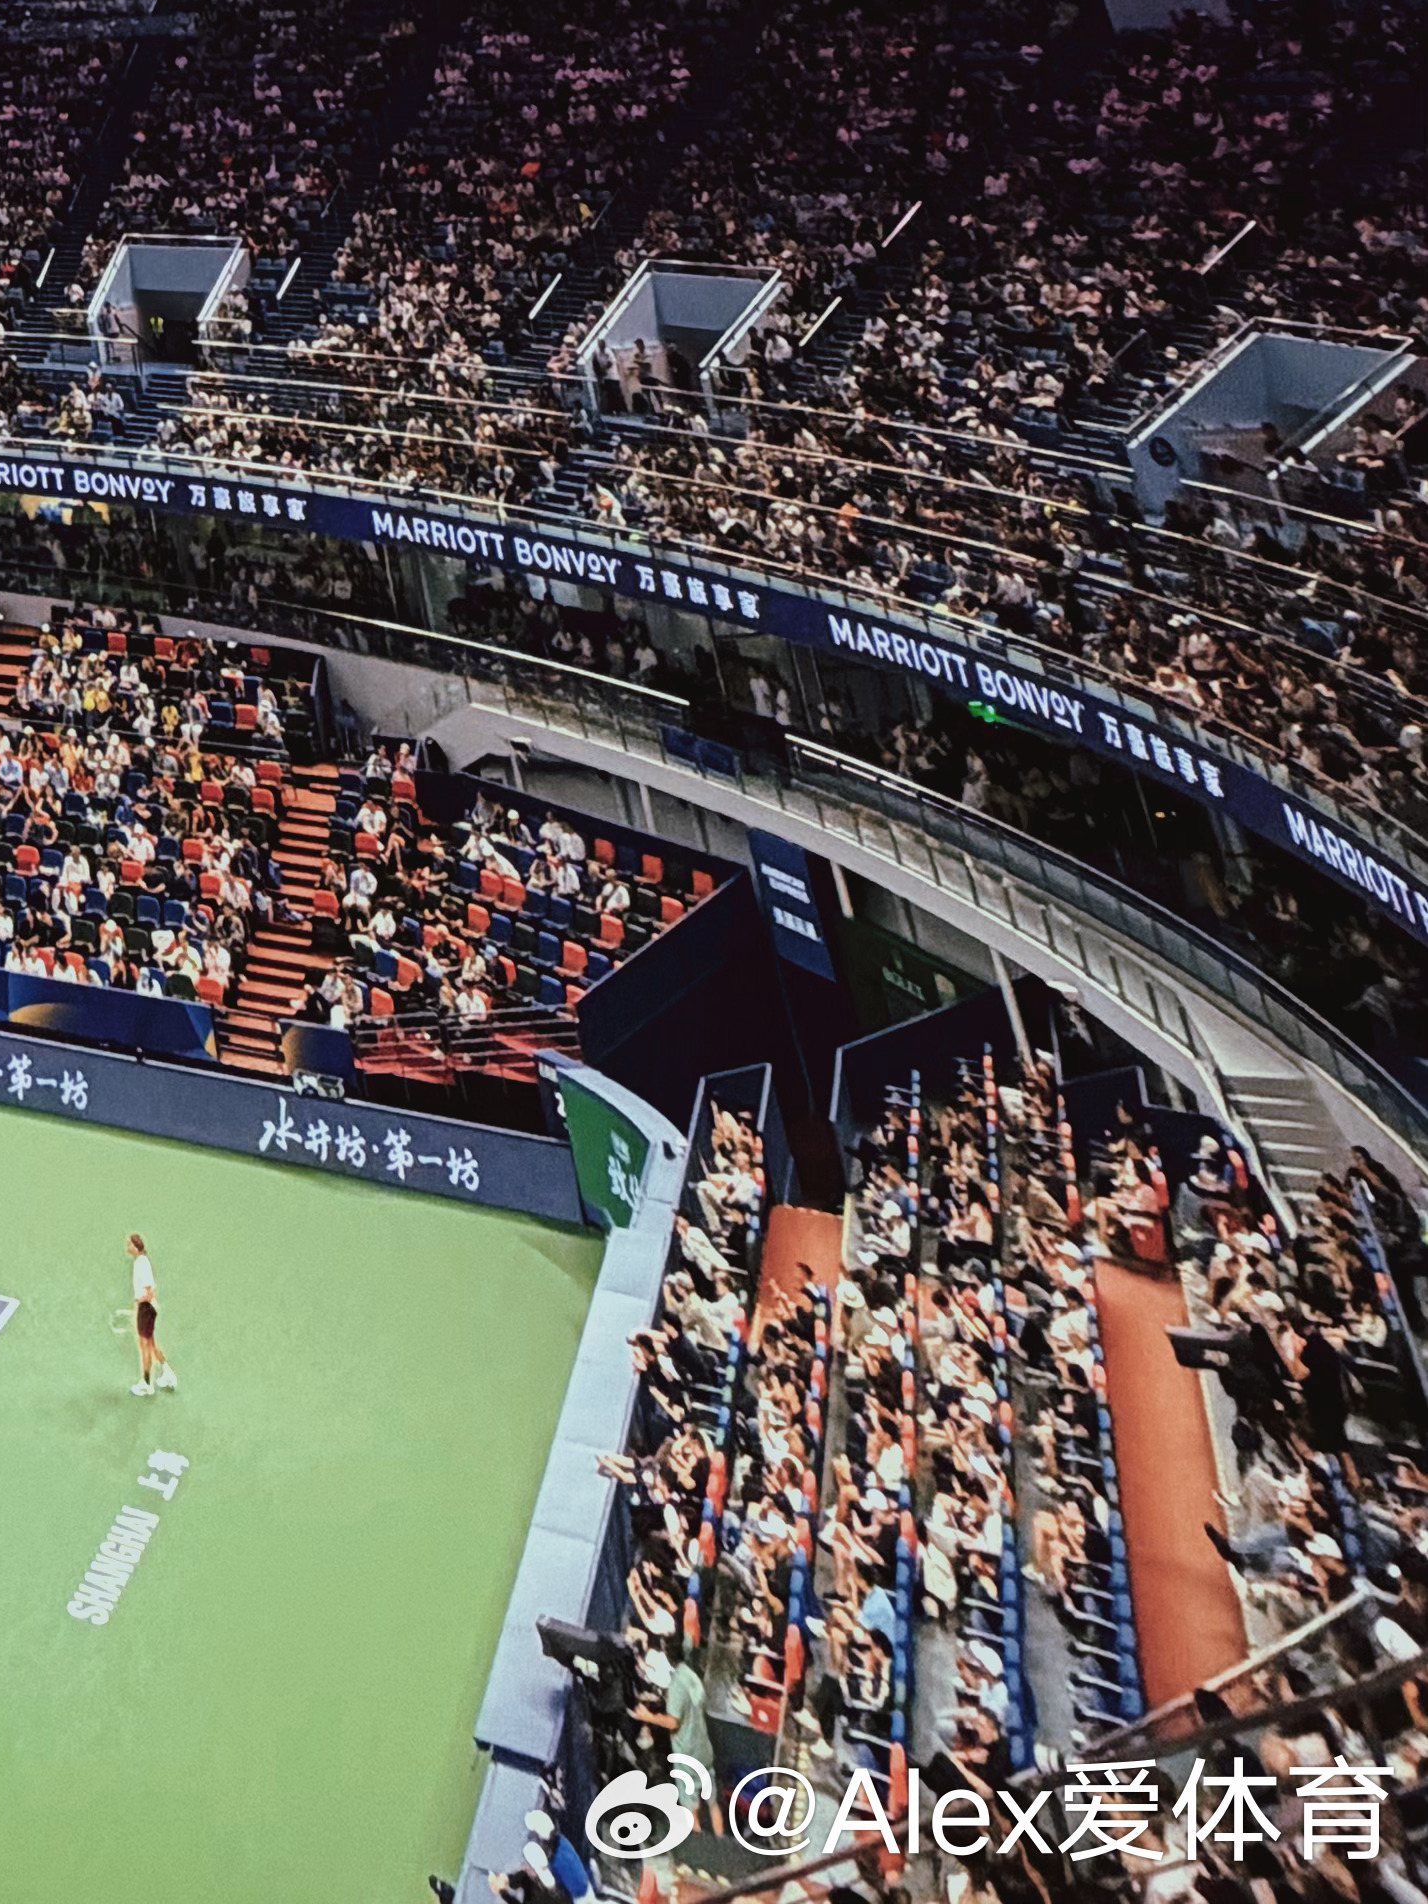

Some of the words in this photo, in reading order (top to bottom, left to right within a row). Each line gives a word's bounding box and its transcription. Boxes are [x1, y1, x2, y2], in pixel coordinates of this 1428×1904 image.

[73, 469, 175, 504] BONVOY
[371, 505, 505, 560] MARRIOTT
[513, 530, 622, 585] BONVOY
[828, 614, 969, 688] MARRIOTT
[975, 661, 1085, 734] BONVOY
[1282, 802, 1416, 924] MARRIOTT
[258, 1095, 480, 1192] 水井坊·第一坊
[67, 1504, 160, 1626] SHANGHAI
